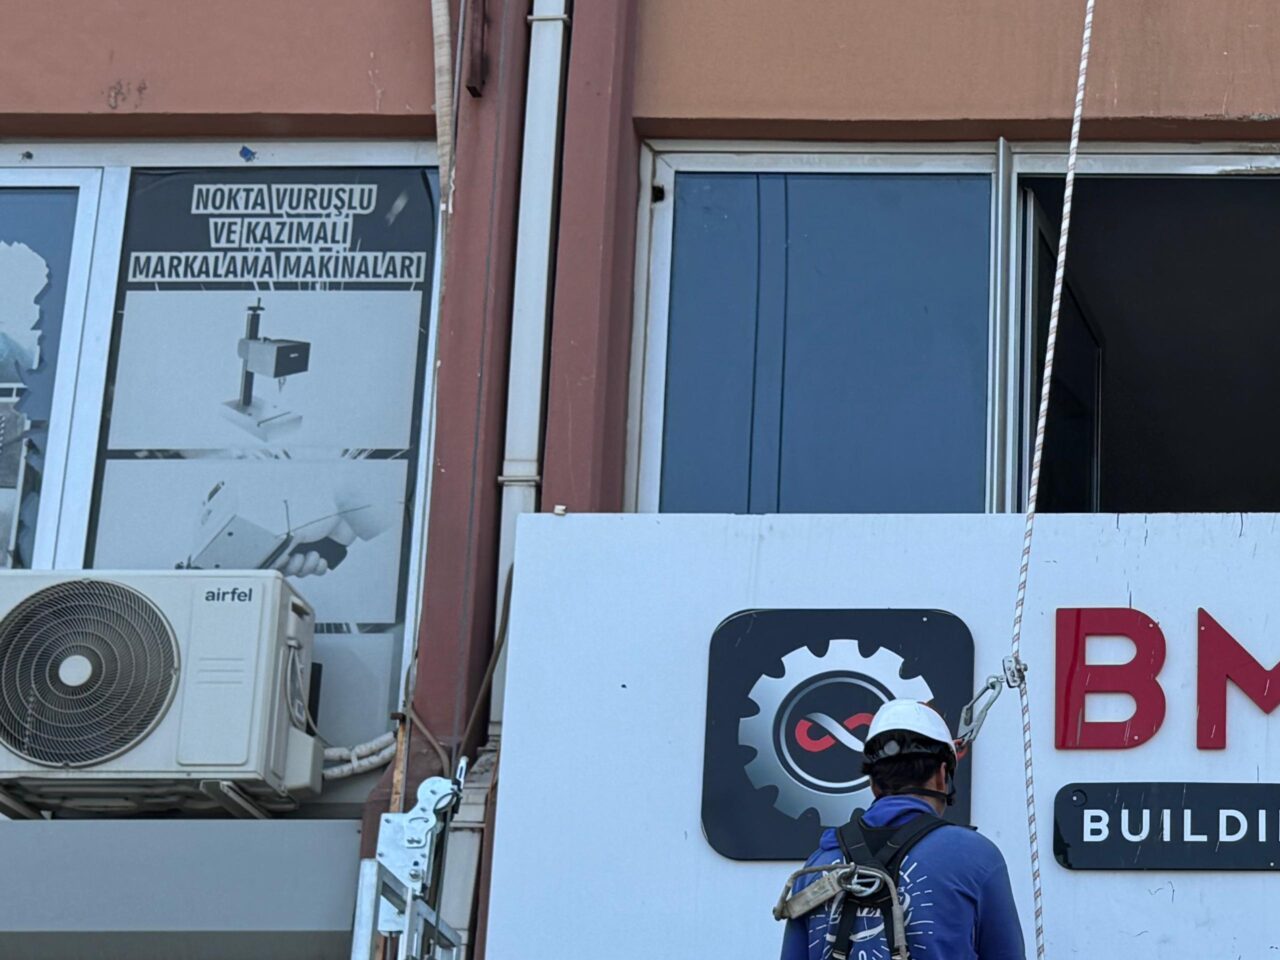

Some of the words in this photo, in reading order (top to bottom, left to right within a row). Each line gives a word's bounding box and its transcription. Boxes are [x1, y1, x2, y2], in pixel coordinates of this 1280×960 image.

[194, 187, 266, 211] NOKTA
[275, 187, 373, 216] VURUŞLU
[213, 220, 237, 244] VE
[131, 255, 274, 279] MARKALAMA
[282, 251, 423, 279] MAKİNALARI
[205, 587, 253, 602] airfel
